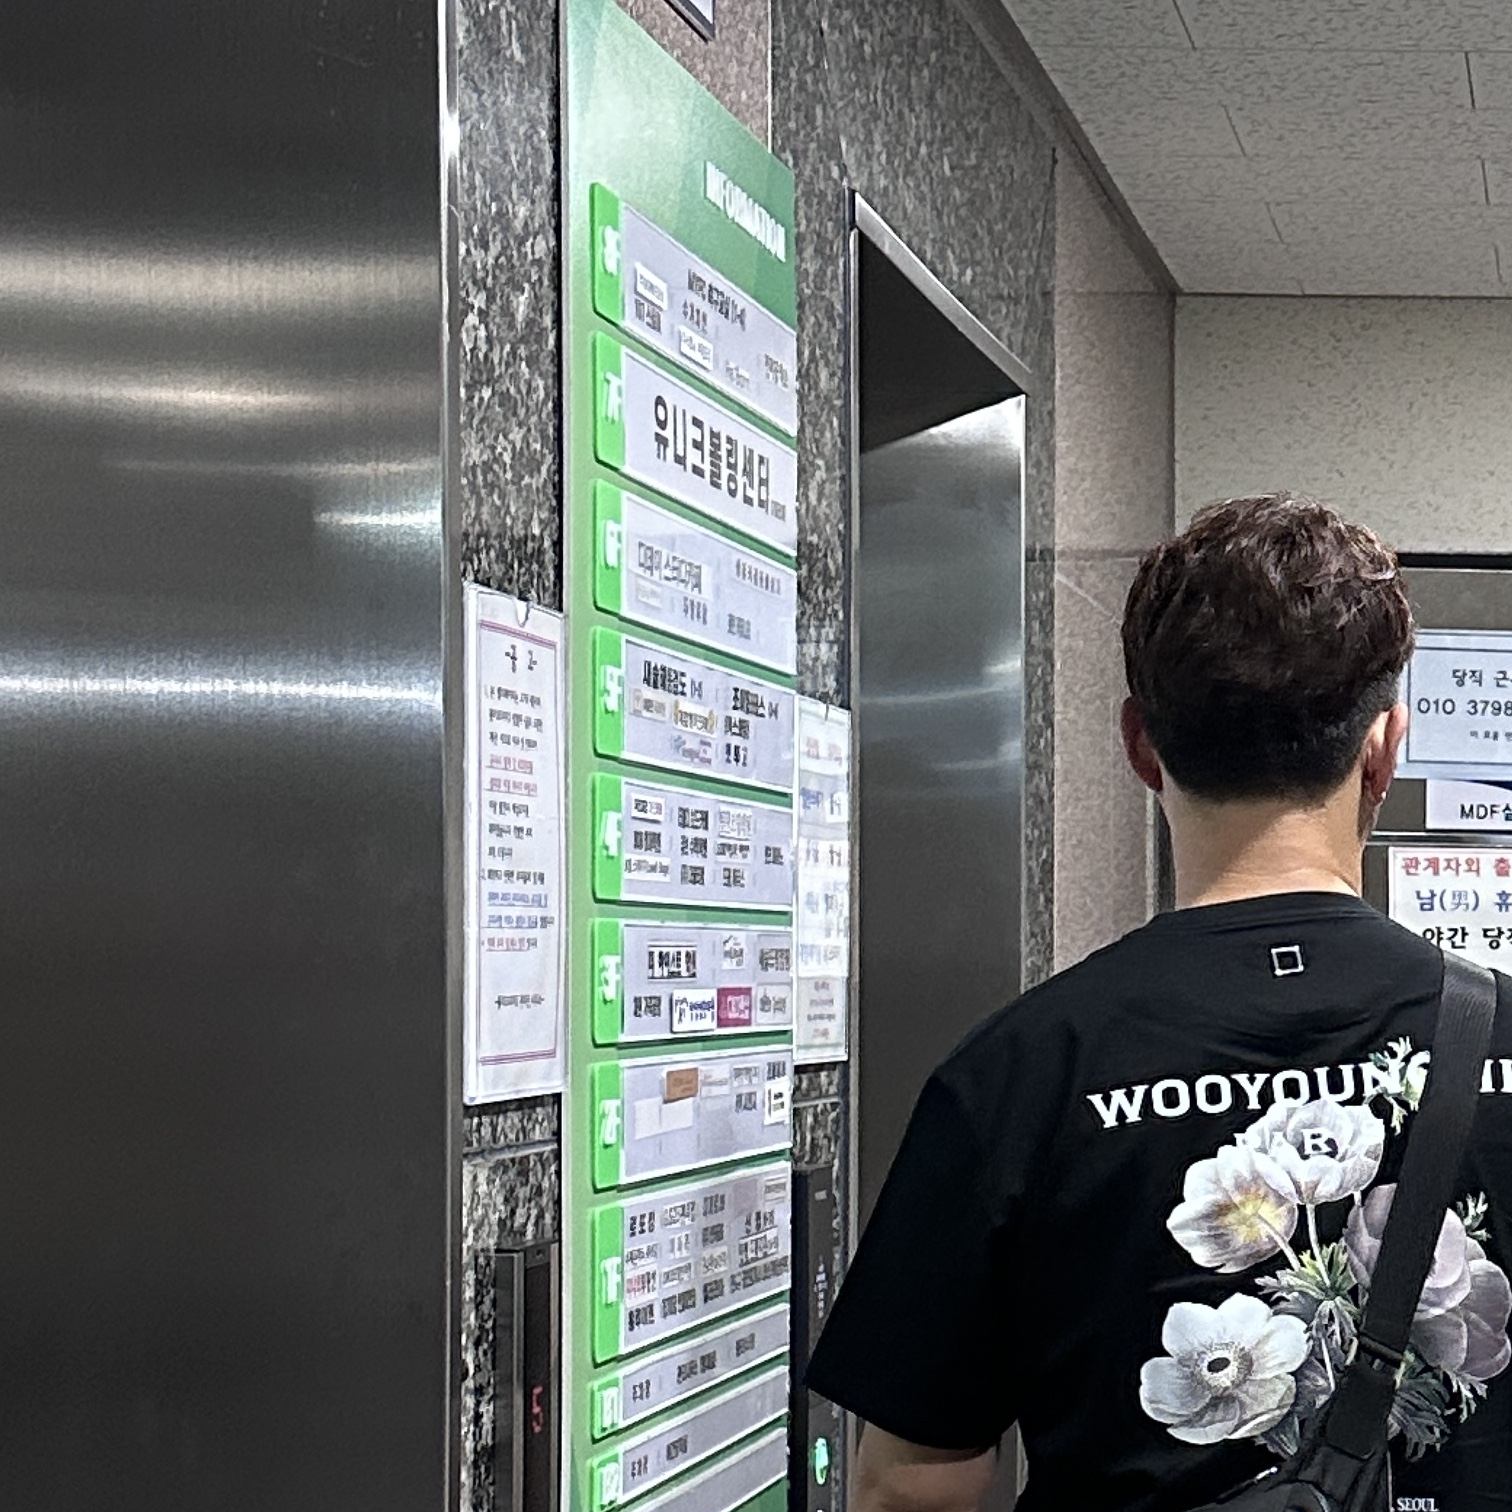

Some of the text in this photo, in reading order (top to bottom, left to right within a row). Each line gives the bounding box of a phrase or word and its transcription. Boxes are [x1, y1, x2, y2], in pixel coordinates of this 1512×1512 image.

[654, 395, 770, 515] 유니크볼링센터
[1452, 669, 1483, 687] 당직
[1417, 698, 1456, 715] 010
[1402, 857, 1482, 877] 관계자외
[1415, 889, 1479, 912] 남(男)
[1422, 926, 1469, 949] 야간
[1397, 1497, 1440, 1512] SEOUL
